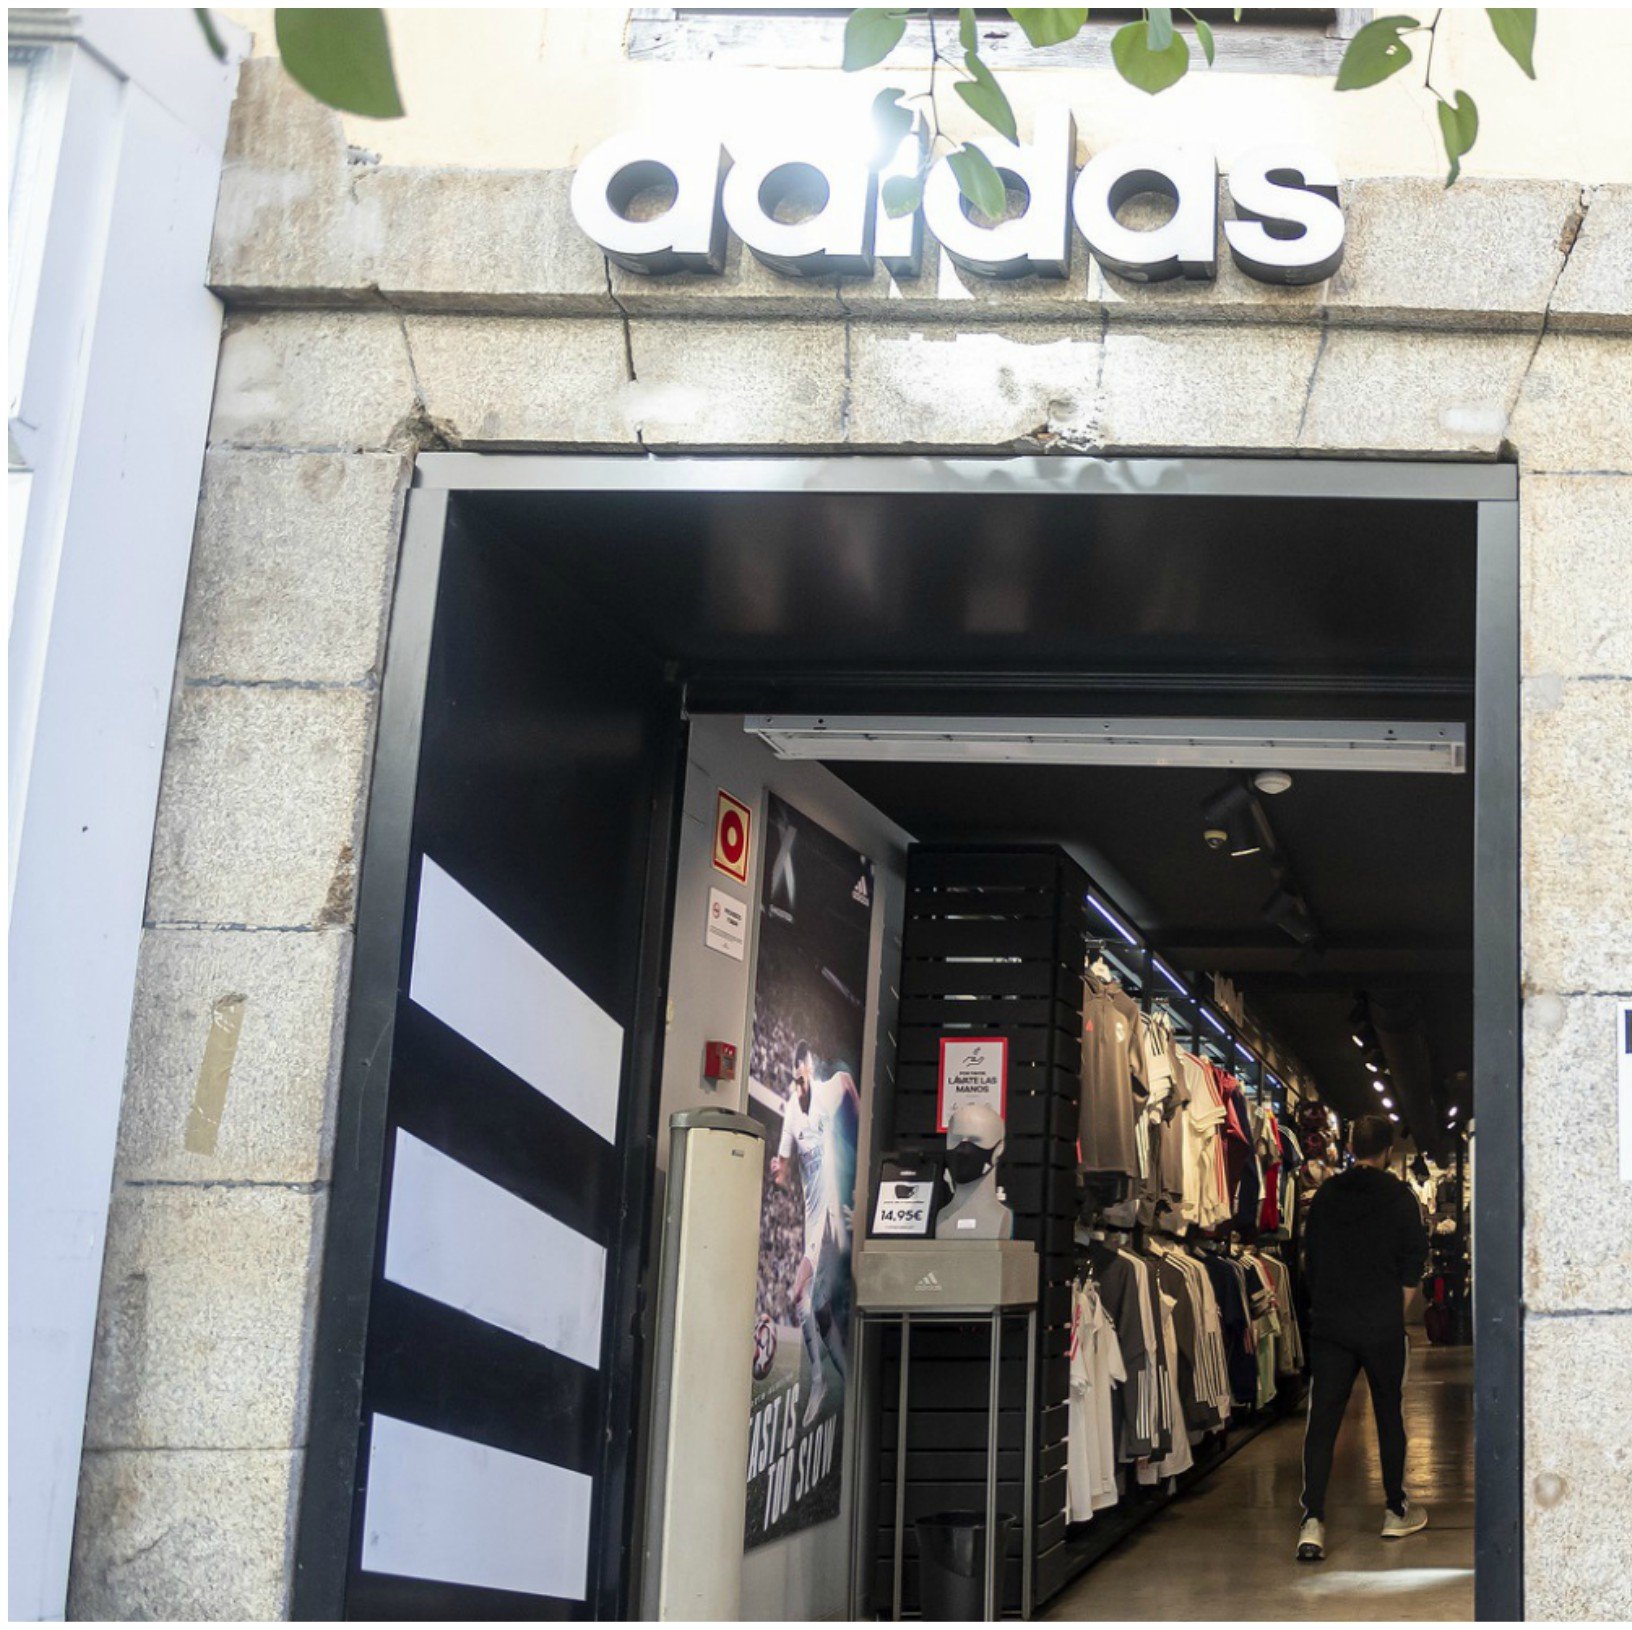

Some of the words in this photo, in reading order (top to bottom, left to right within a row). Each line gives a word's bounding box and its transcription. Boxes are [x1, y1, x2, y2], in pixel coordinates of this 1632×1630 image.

[570, 109, 1346, 284] adidas
[956, 1085, 989, 1093] MANOS
[980, 1076, 997, 1085] LAS
[747, 1396, 782, 1483] AST
[780, 1382, 800, 1456] IS
[763, 1448, 795, 1531] TOO
[795, 1413, 837, 1501] SLOW
